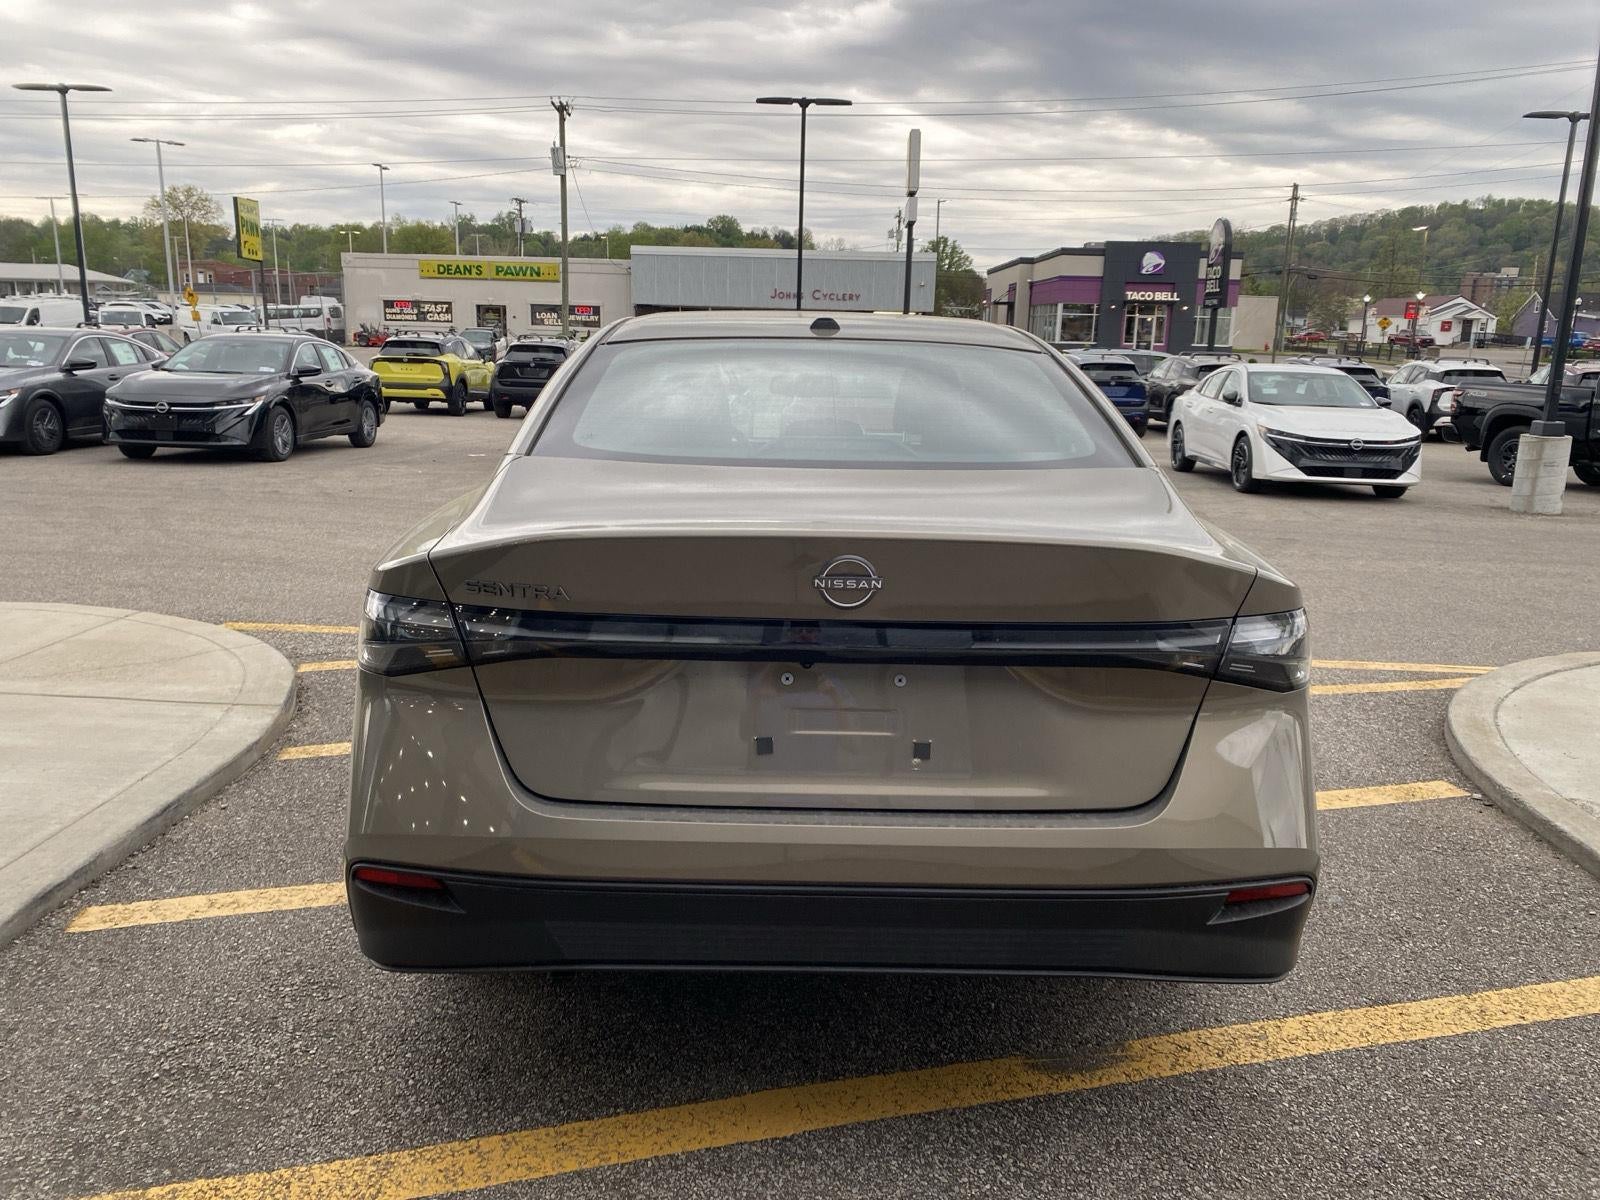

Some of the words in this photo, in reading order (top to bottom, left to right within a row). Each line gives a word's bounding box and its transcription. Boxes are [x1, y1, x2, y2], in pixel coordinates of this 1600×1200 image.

[240, 216, 260, 238] PAWN
[436, 264, 483, 276] DEAN'S
[495, 265, 541, 277] PAWN
[1206, 266, 1222, 279] TACO
[1205, 279, 1221, 292] BELL
[1125, 291, 1154, 300] TACO
[1154, 291, 1180, 301] BELL
[424, 304, 449, 312] FAST
[427, 313, 452, 321] CASH
[464, 580, 571, 601] SENTRA
[814, 579, 882, 589] NISSAN
